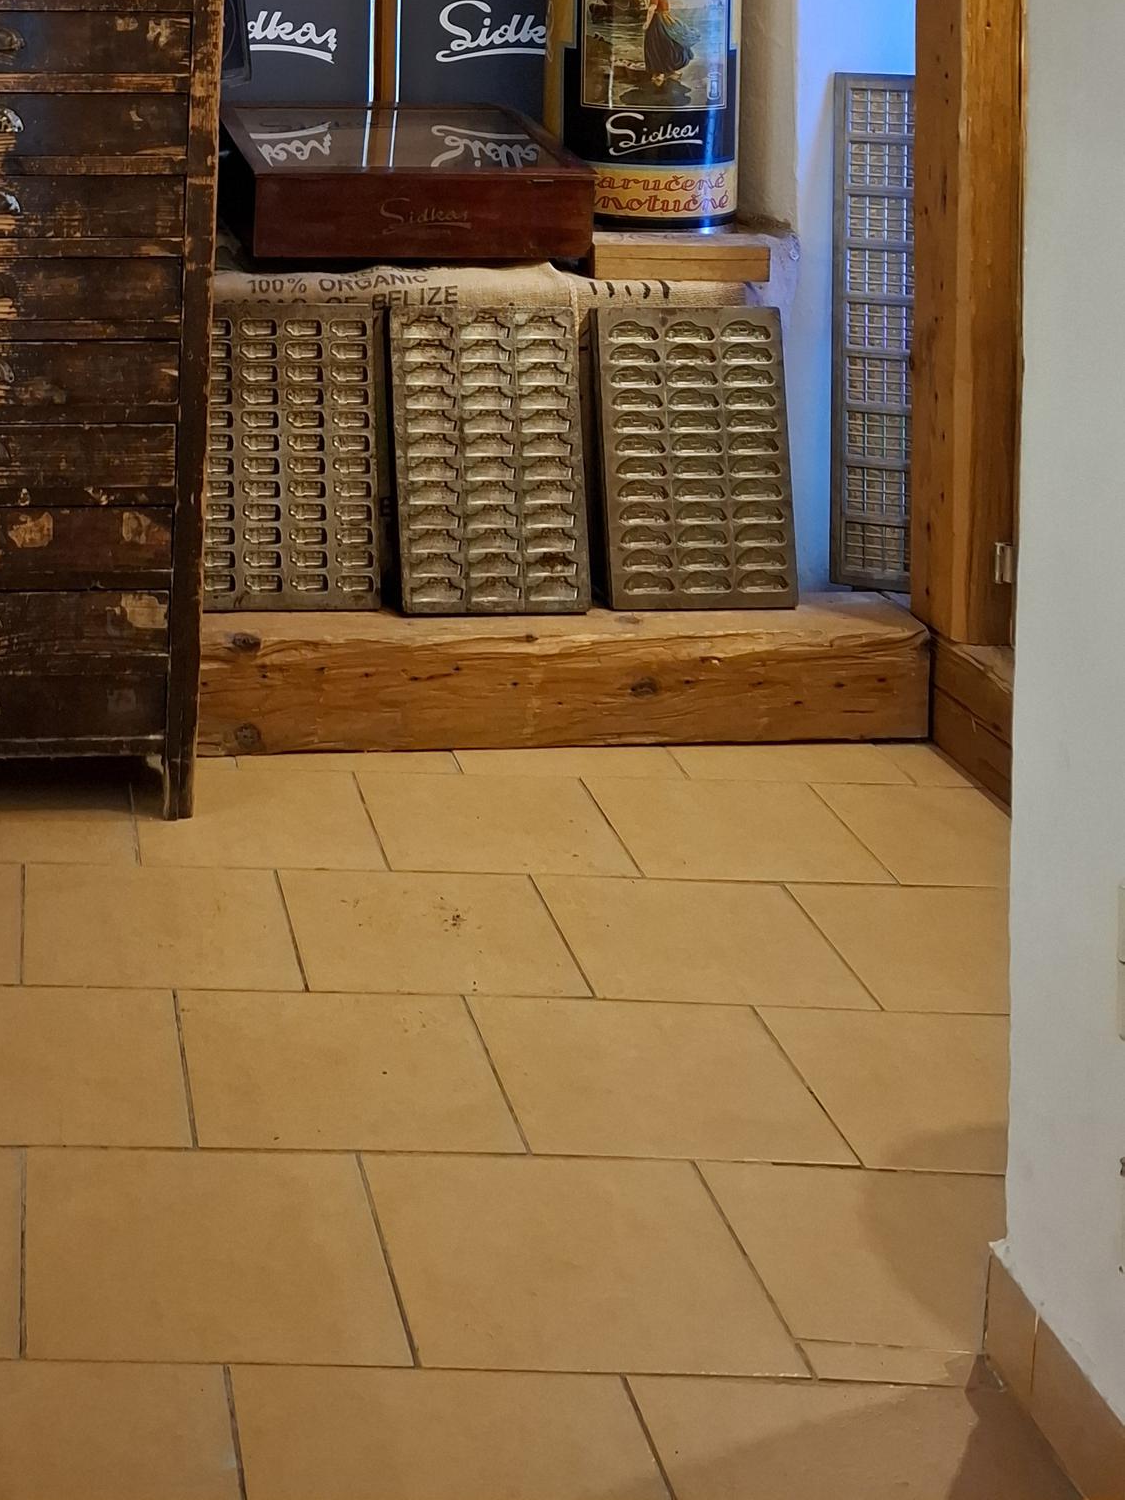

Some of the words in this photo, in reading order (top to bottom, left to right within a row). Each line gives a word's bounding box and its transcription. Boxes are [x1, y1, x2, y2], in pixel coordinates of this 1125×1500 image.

[595, 172, 727, 192] aručeně
[594, 190, 729, 213] notučné
[248, 277, 308, 295] 100%
[319, 272, 430, 293] ORGANIC
